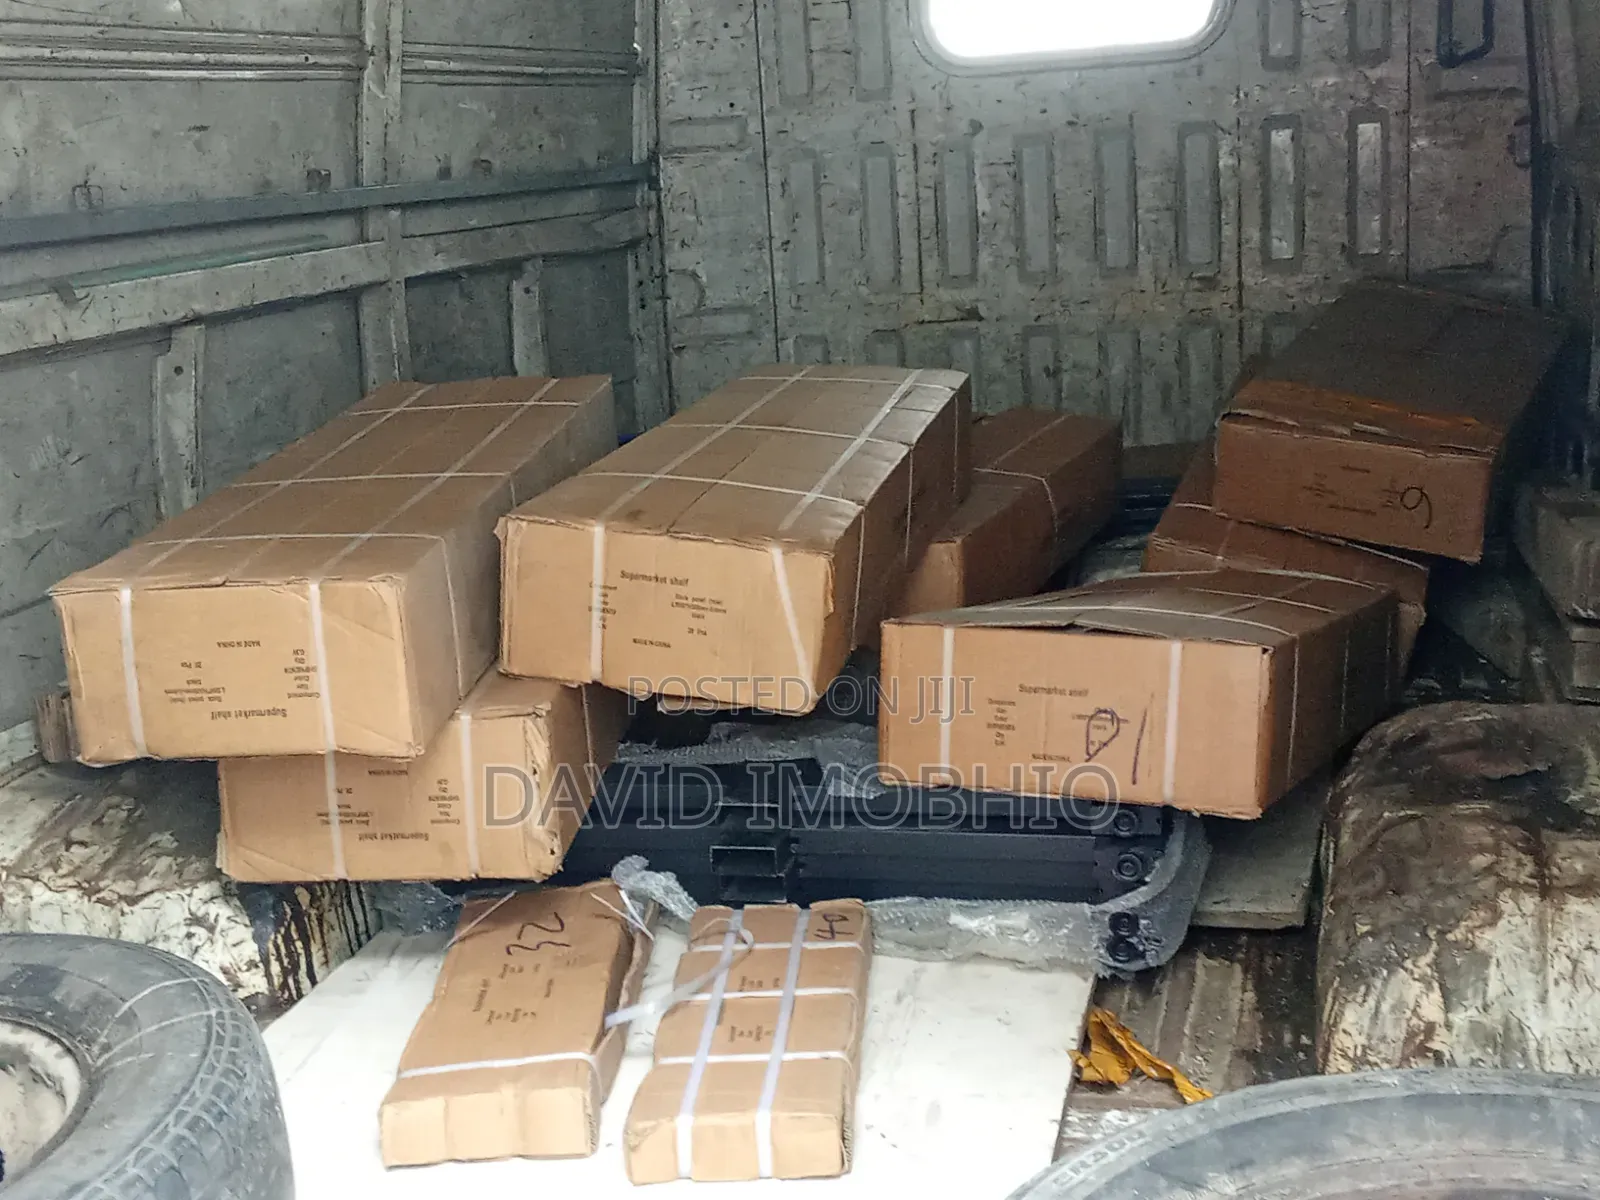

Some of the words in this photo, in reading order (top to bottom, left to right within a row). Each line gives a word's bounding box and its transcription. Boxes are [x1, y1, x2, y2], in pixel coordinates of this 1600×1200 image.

[620, 569, 667, 585] Supermarket
[670, 577, 689, 587] shelf
[217, 641, 236, 649] CHINA
[244, 640, 261, 648] MADE
[1018, 683, 1066, 697] Supermarket
[1068, 687, 1089, 698] shelf
[211, 711, 232, 720] shelf
[234, 707, 287, 719] Supermarket
[358, 832, 378, 841] shelf
[379, 832, 429, 841] Supermarket
